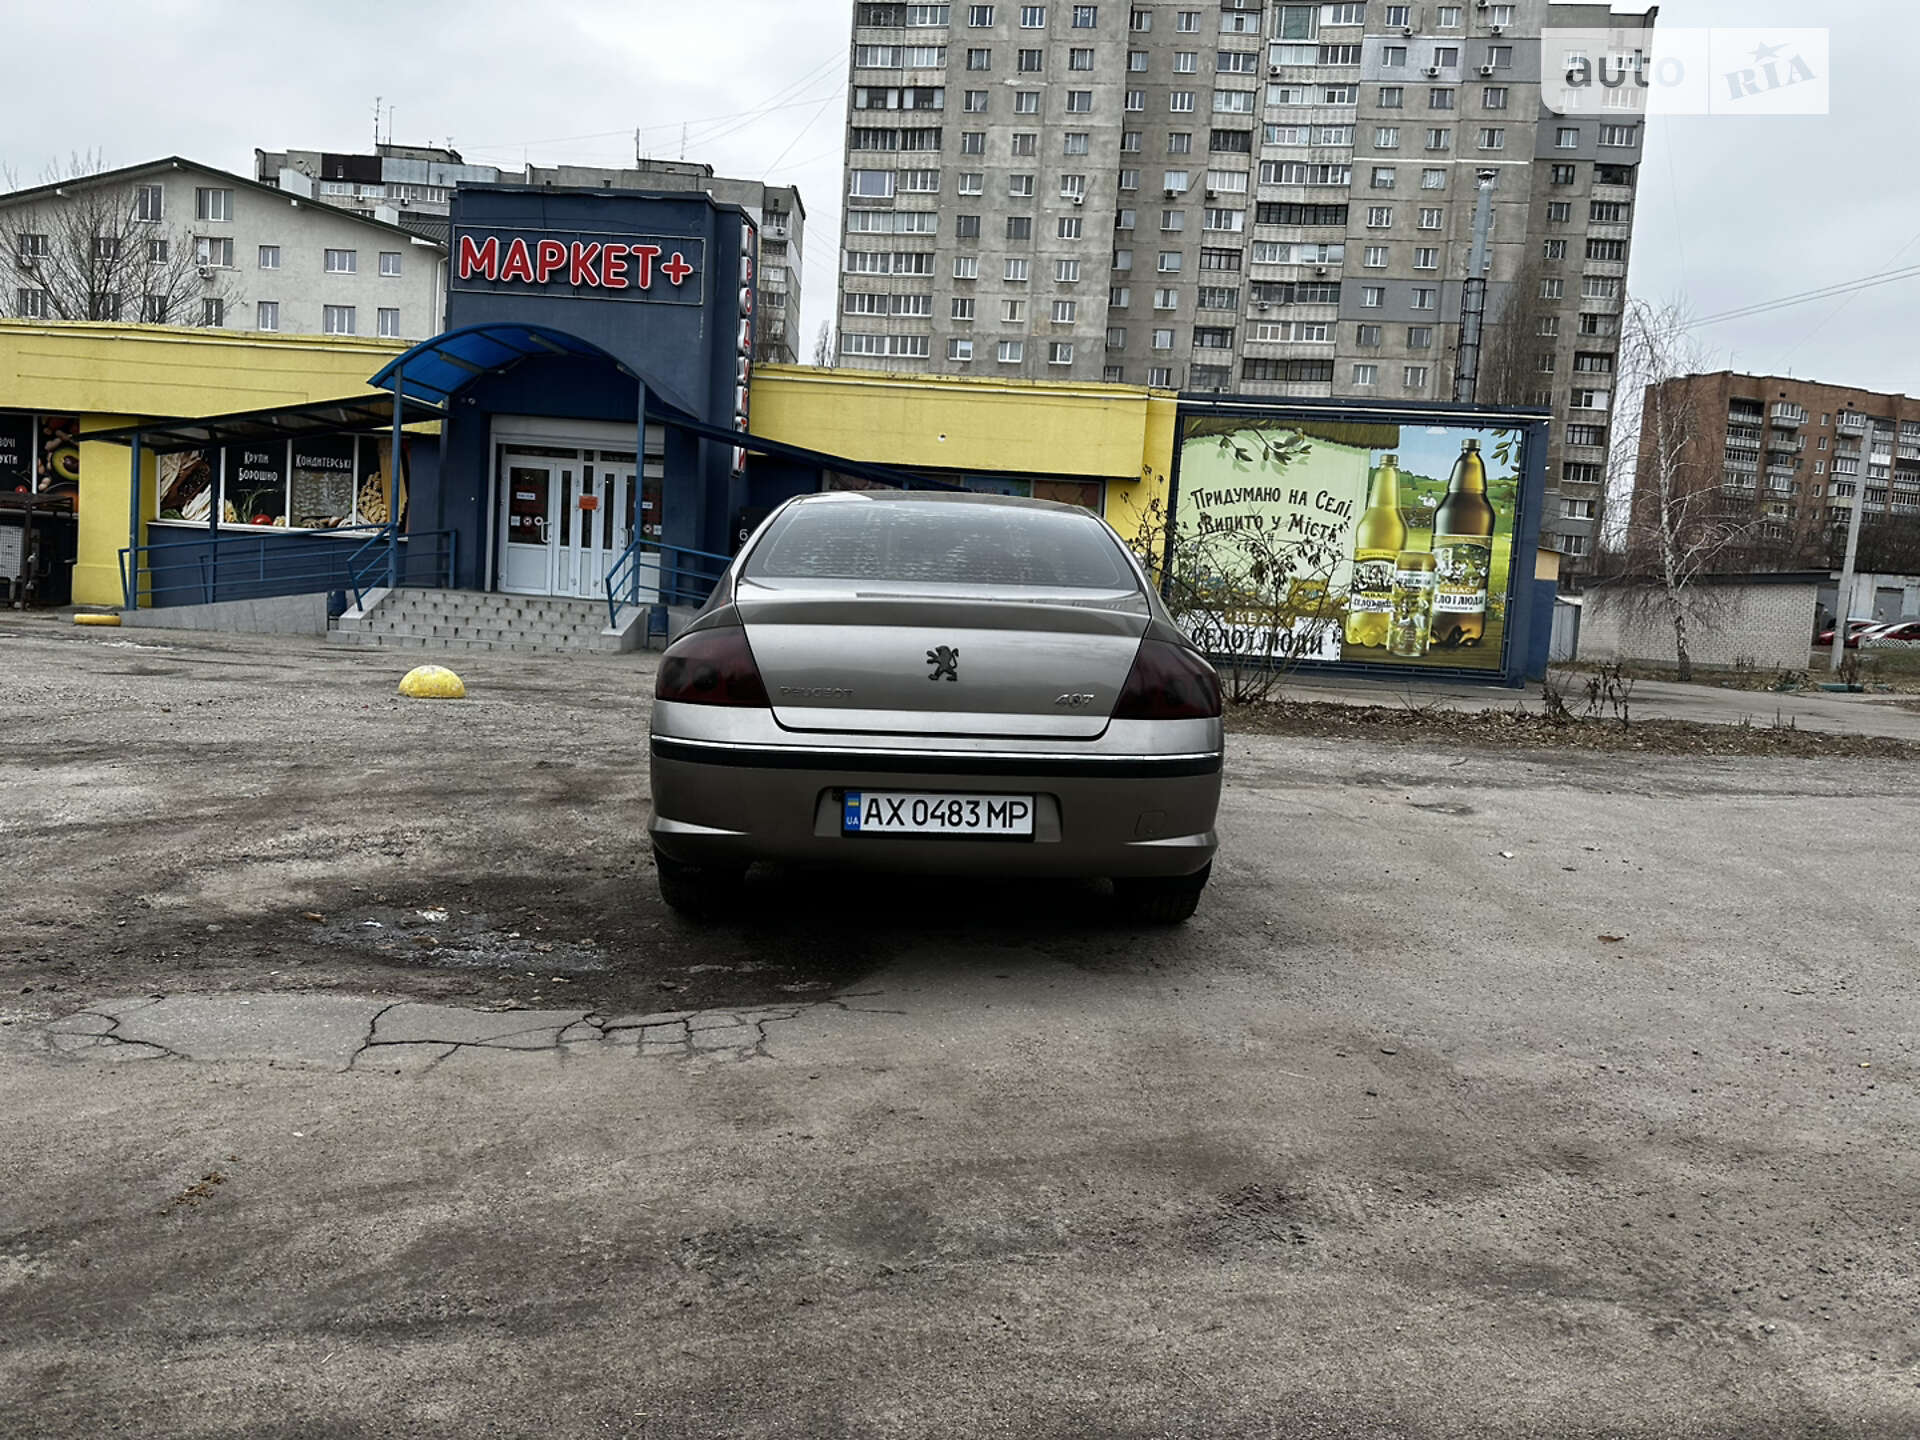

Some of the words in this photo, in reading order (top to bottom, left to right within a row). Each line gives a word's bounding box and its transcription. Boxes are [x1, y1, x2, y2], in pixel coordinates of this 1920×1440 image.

[1190, 487, 1281, 510] Придумано
[1288, 489, 1308, 506] на
[1271, 516, 1281, 530] у
[847, 816, 859, 825] UA
[864, 798, 906, 826] AX
[912, 799, 980, 828] 0483
[987, 800, 1029, 828] MP
